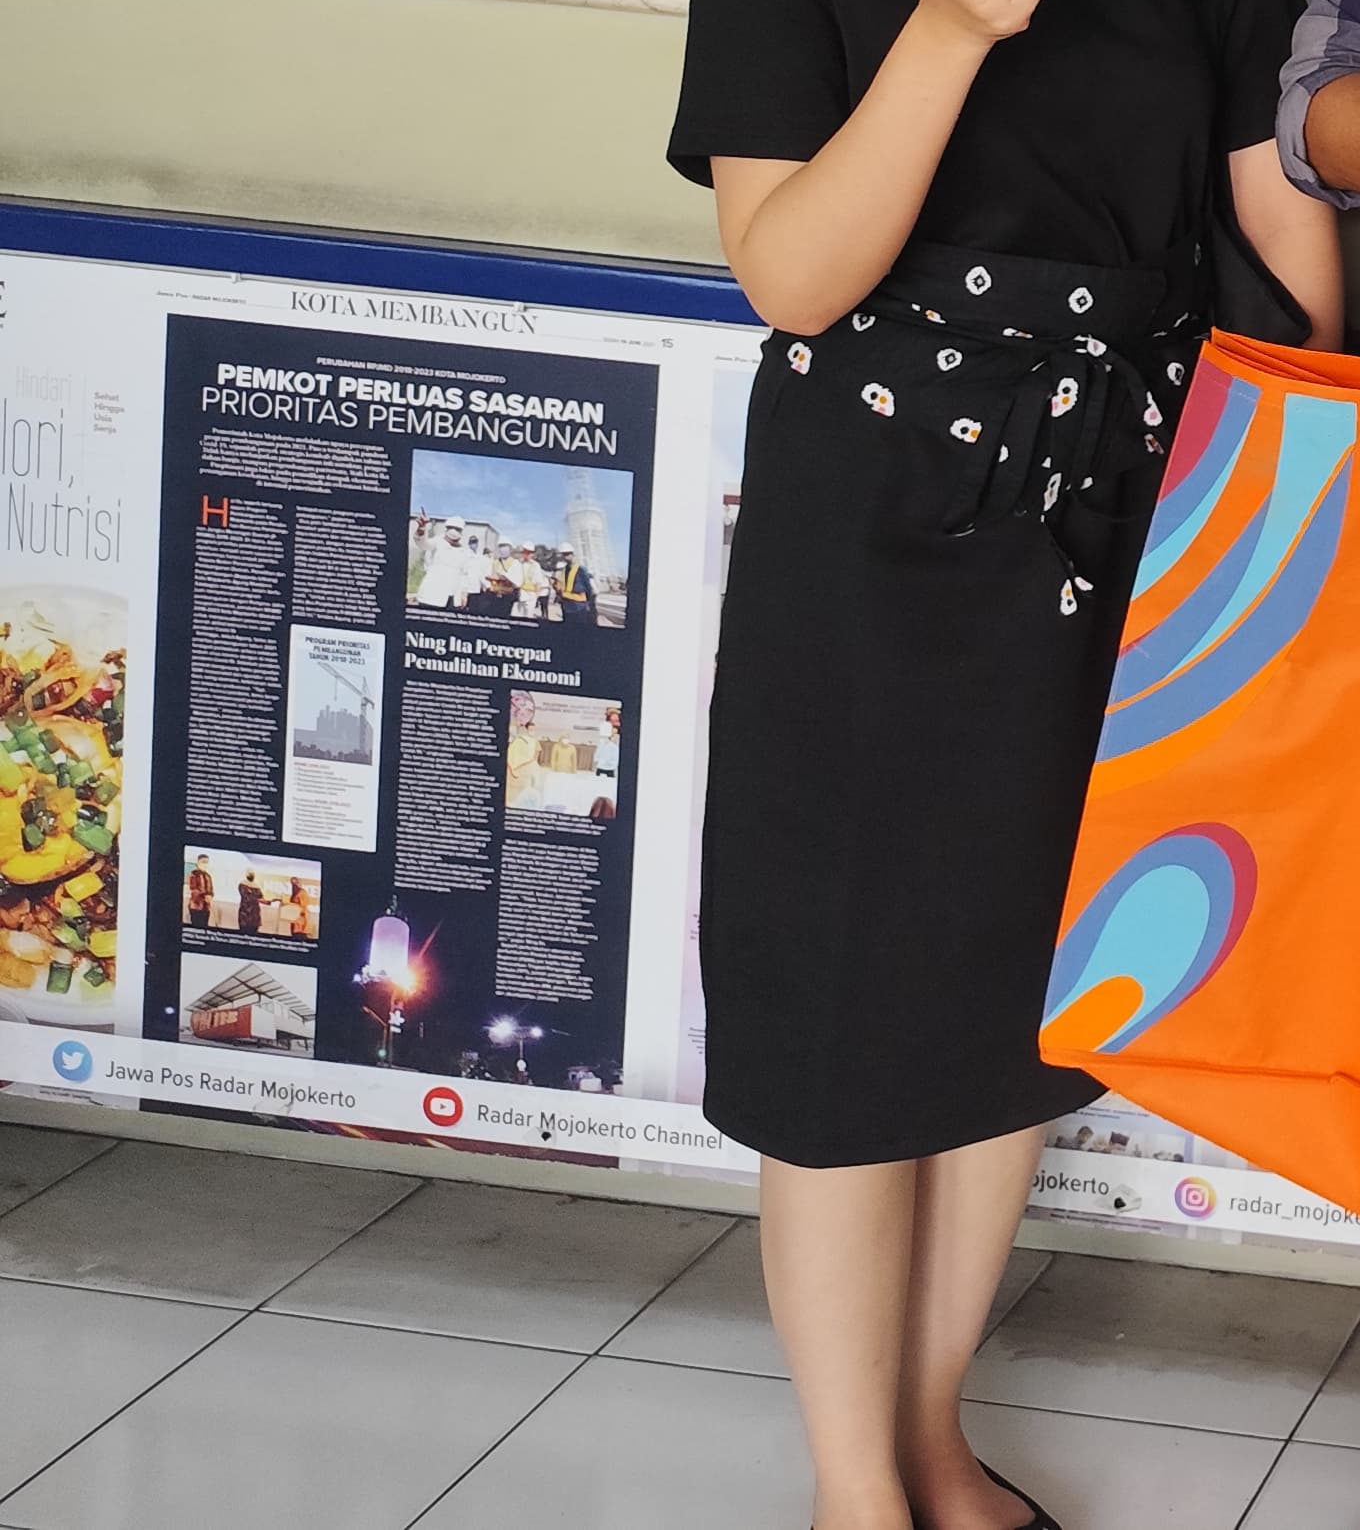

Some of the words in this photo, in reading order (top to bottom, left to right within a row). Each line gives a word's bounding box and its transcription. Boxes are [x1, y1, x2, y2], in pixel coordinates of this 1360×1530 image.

[291, 291, 357, 315] KOTA
[365, 298, 538, 334] MEMBANGUN
[661, 338, 674, 349] 15
[15, 366, 72, 402] Hindari
[94, 391, 120, 402] Sehat
[218, 363, 333, 396] PEMKOT
[339, 376, 463, 411] PERLUAS
[469, 390, 604, 425] SASARAN
[202, 386, 358, 428] PRIORITAS
[368, 404, 617, 455] PEMBANGUNAN
[8, 482, 120, 563] Nutrisi
[202, 495, 229, 528] H
[305, 637, 336, 648] PROGRAM
[338, 640, 370, 650] PRIORITAS
[309, 652, 329, 661] TAHUN
[405, 631, 446, 654] Ning
[450, 636, 471, 652] Ita
[475, 640, 551, 662] Percepat
[404, 652, 499, 677] Pemulihan
[502, 663, 580, 687] Ekonomi
[106, 1061, 153, 1082] Jawa
[161, 1068, 193, 1088] Pos
[200, 1072, 254, 1095] Radar
[261, 1080, 356, 1108] Mojokerto
[478, 1104, 534, 1127] Radar
[540, 1112, 636, 1140] Mojokerto
[643, 1124, 722, 1150] Channel
[1032, 1172, 1109, 1195] jokerto
